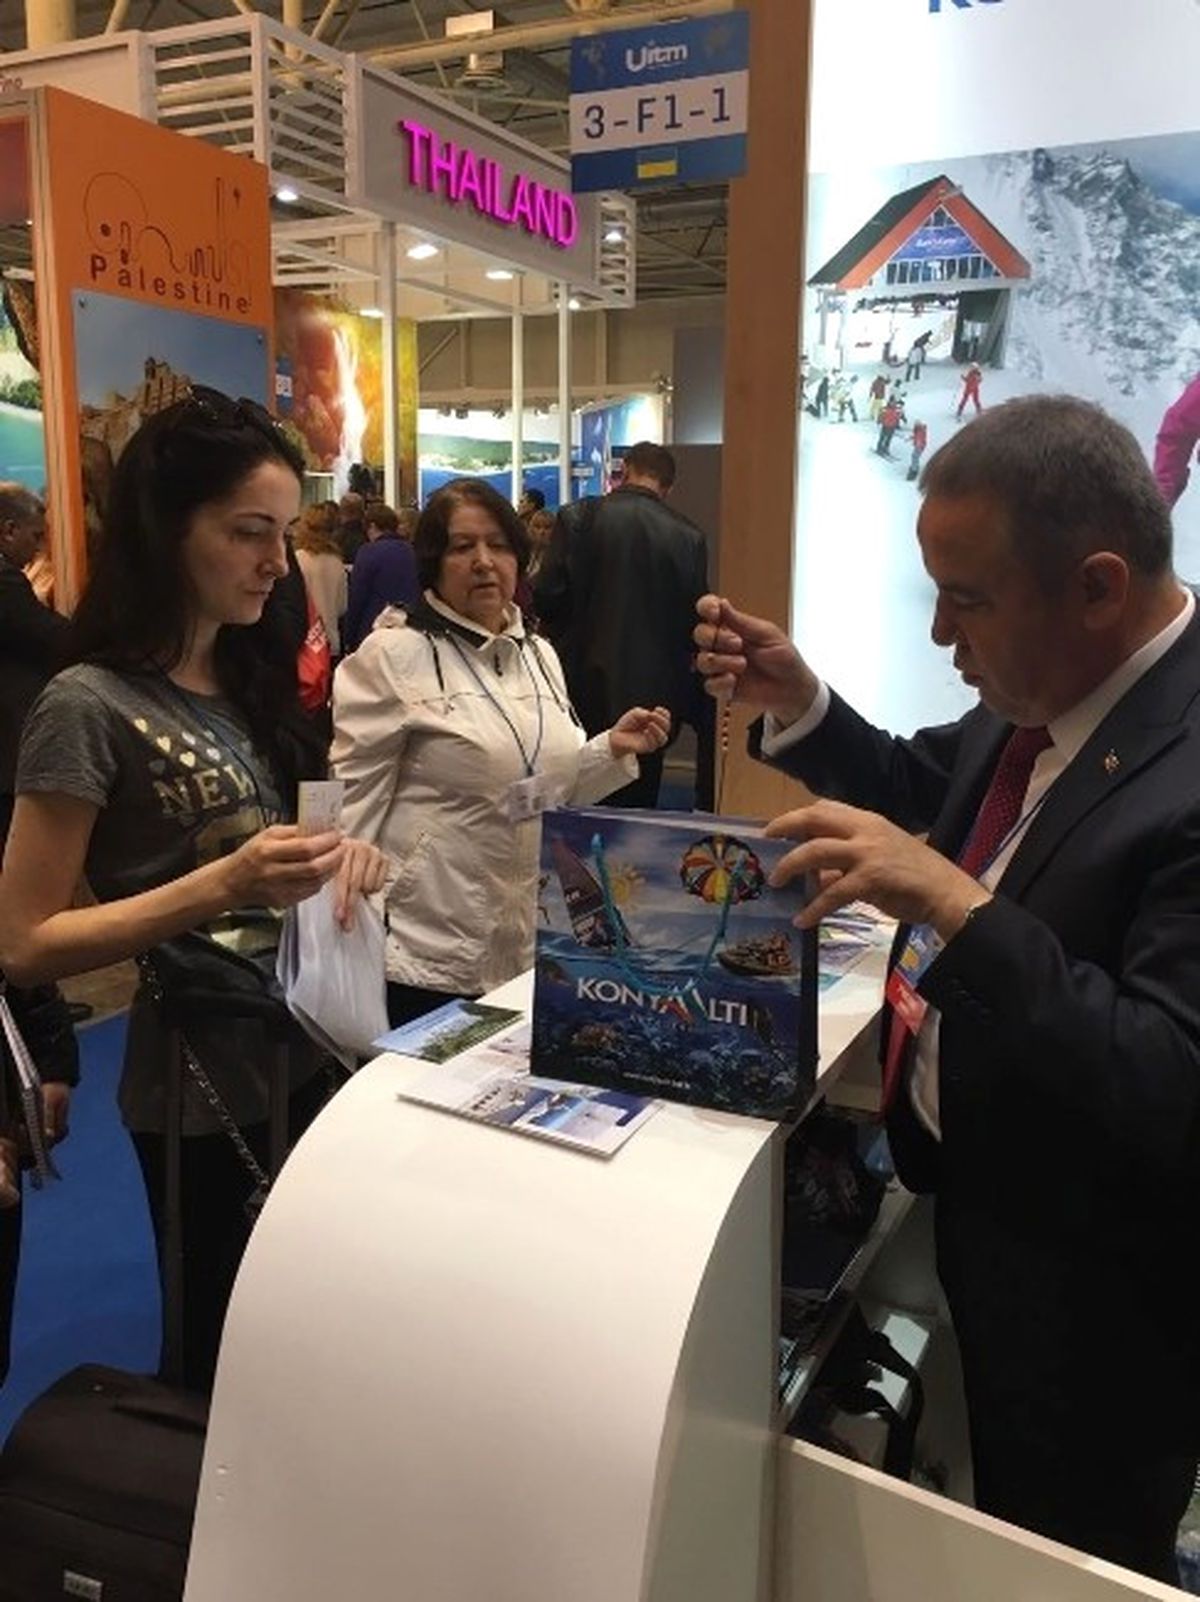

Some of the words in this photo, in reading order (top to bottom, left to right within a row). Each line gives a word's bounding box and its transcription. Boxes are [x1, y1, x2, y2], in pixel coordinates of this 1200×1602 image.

[584, 87, 730, 139] 3-F1-1
[399, 119, 577, 249] THAILAND
[90, 253, 248, 314] Palestine
